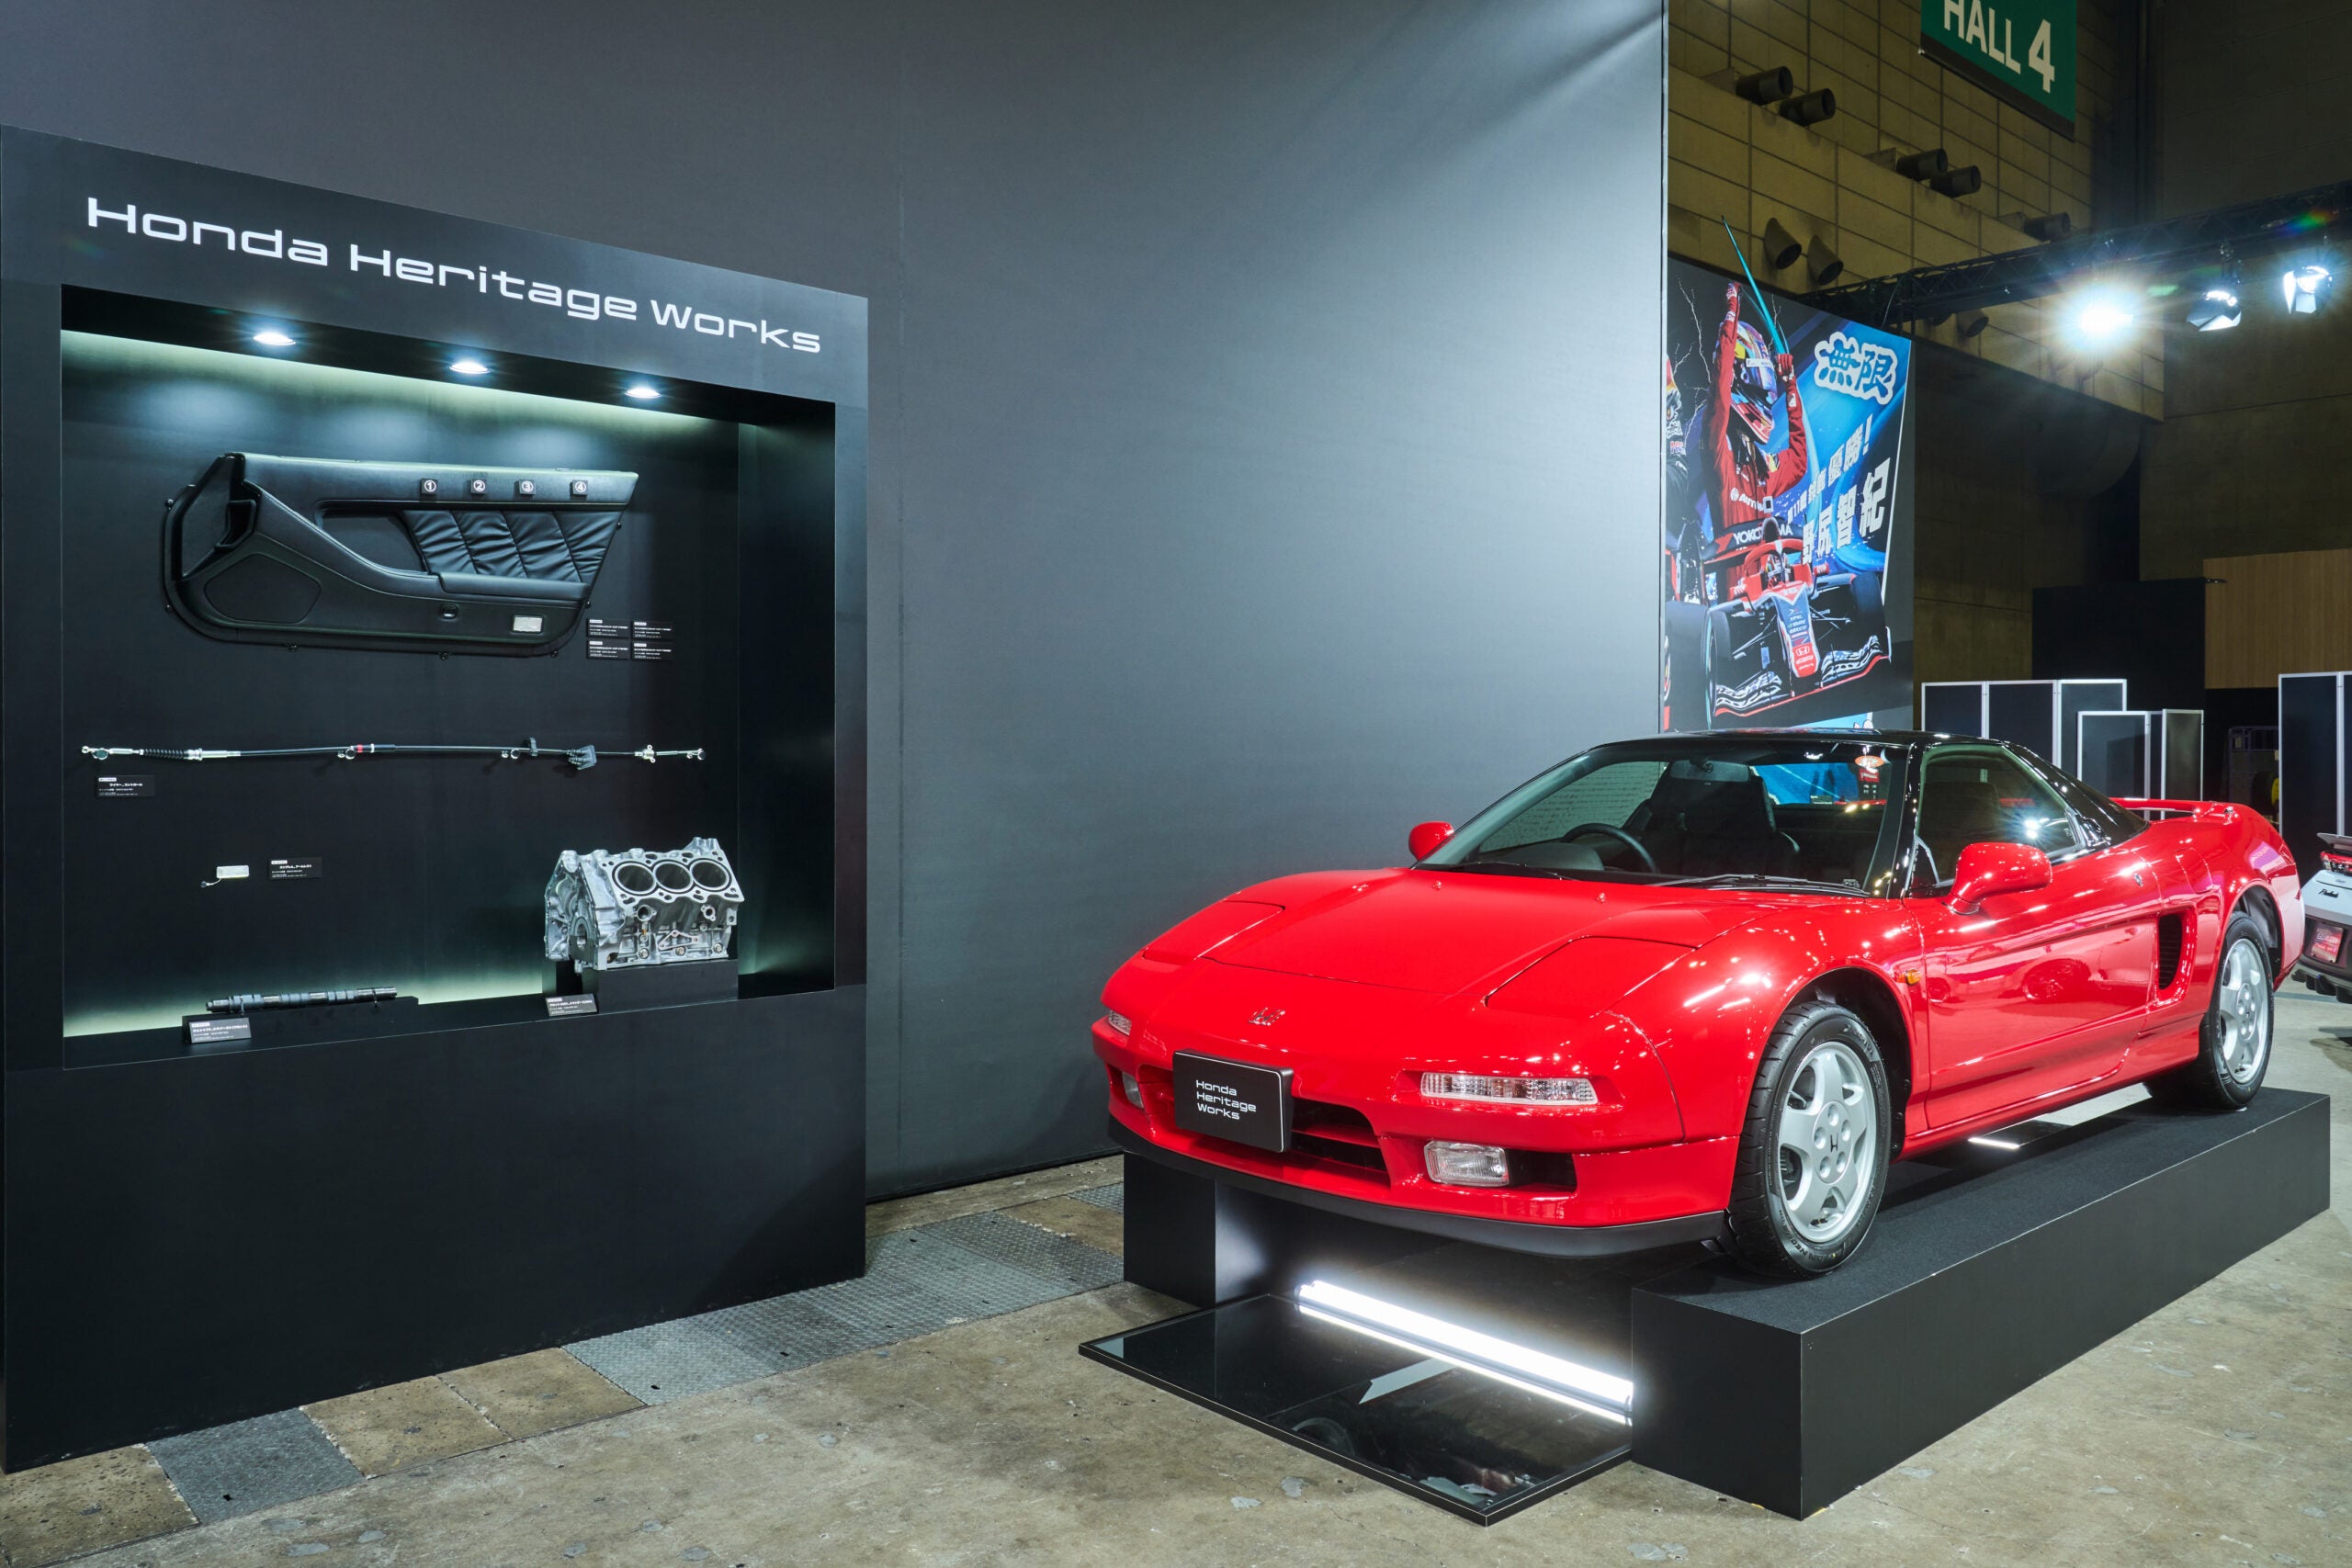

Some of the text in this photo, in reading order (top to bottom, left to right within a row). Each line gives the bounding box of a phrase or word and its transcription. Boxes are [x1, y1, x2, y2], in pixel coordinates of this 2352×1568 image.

[1944, 0, 2055, 94] HALL 4
[88, 197, 820, 354] Honda Heritage Works
[1817, 337, 1894, 400] 無限
[1733, 524, 1793, 545] YOKOMA
[1195, 1079, 1237, 1096] Honda
[1196, 1091, 1257, 1112] Heritage
[1197, 1102, 1240, 1120] Works
